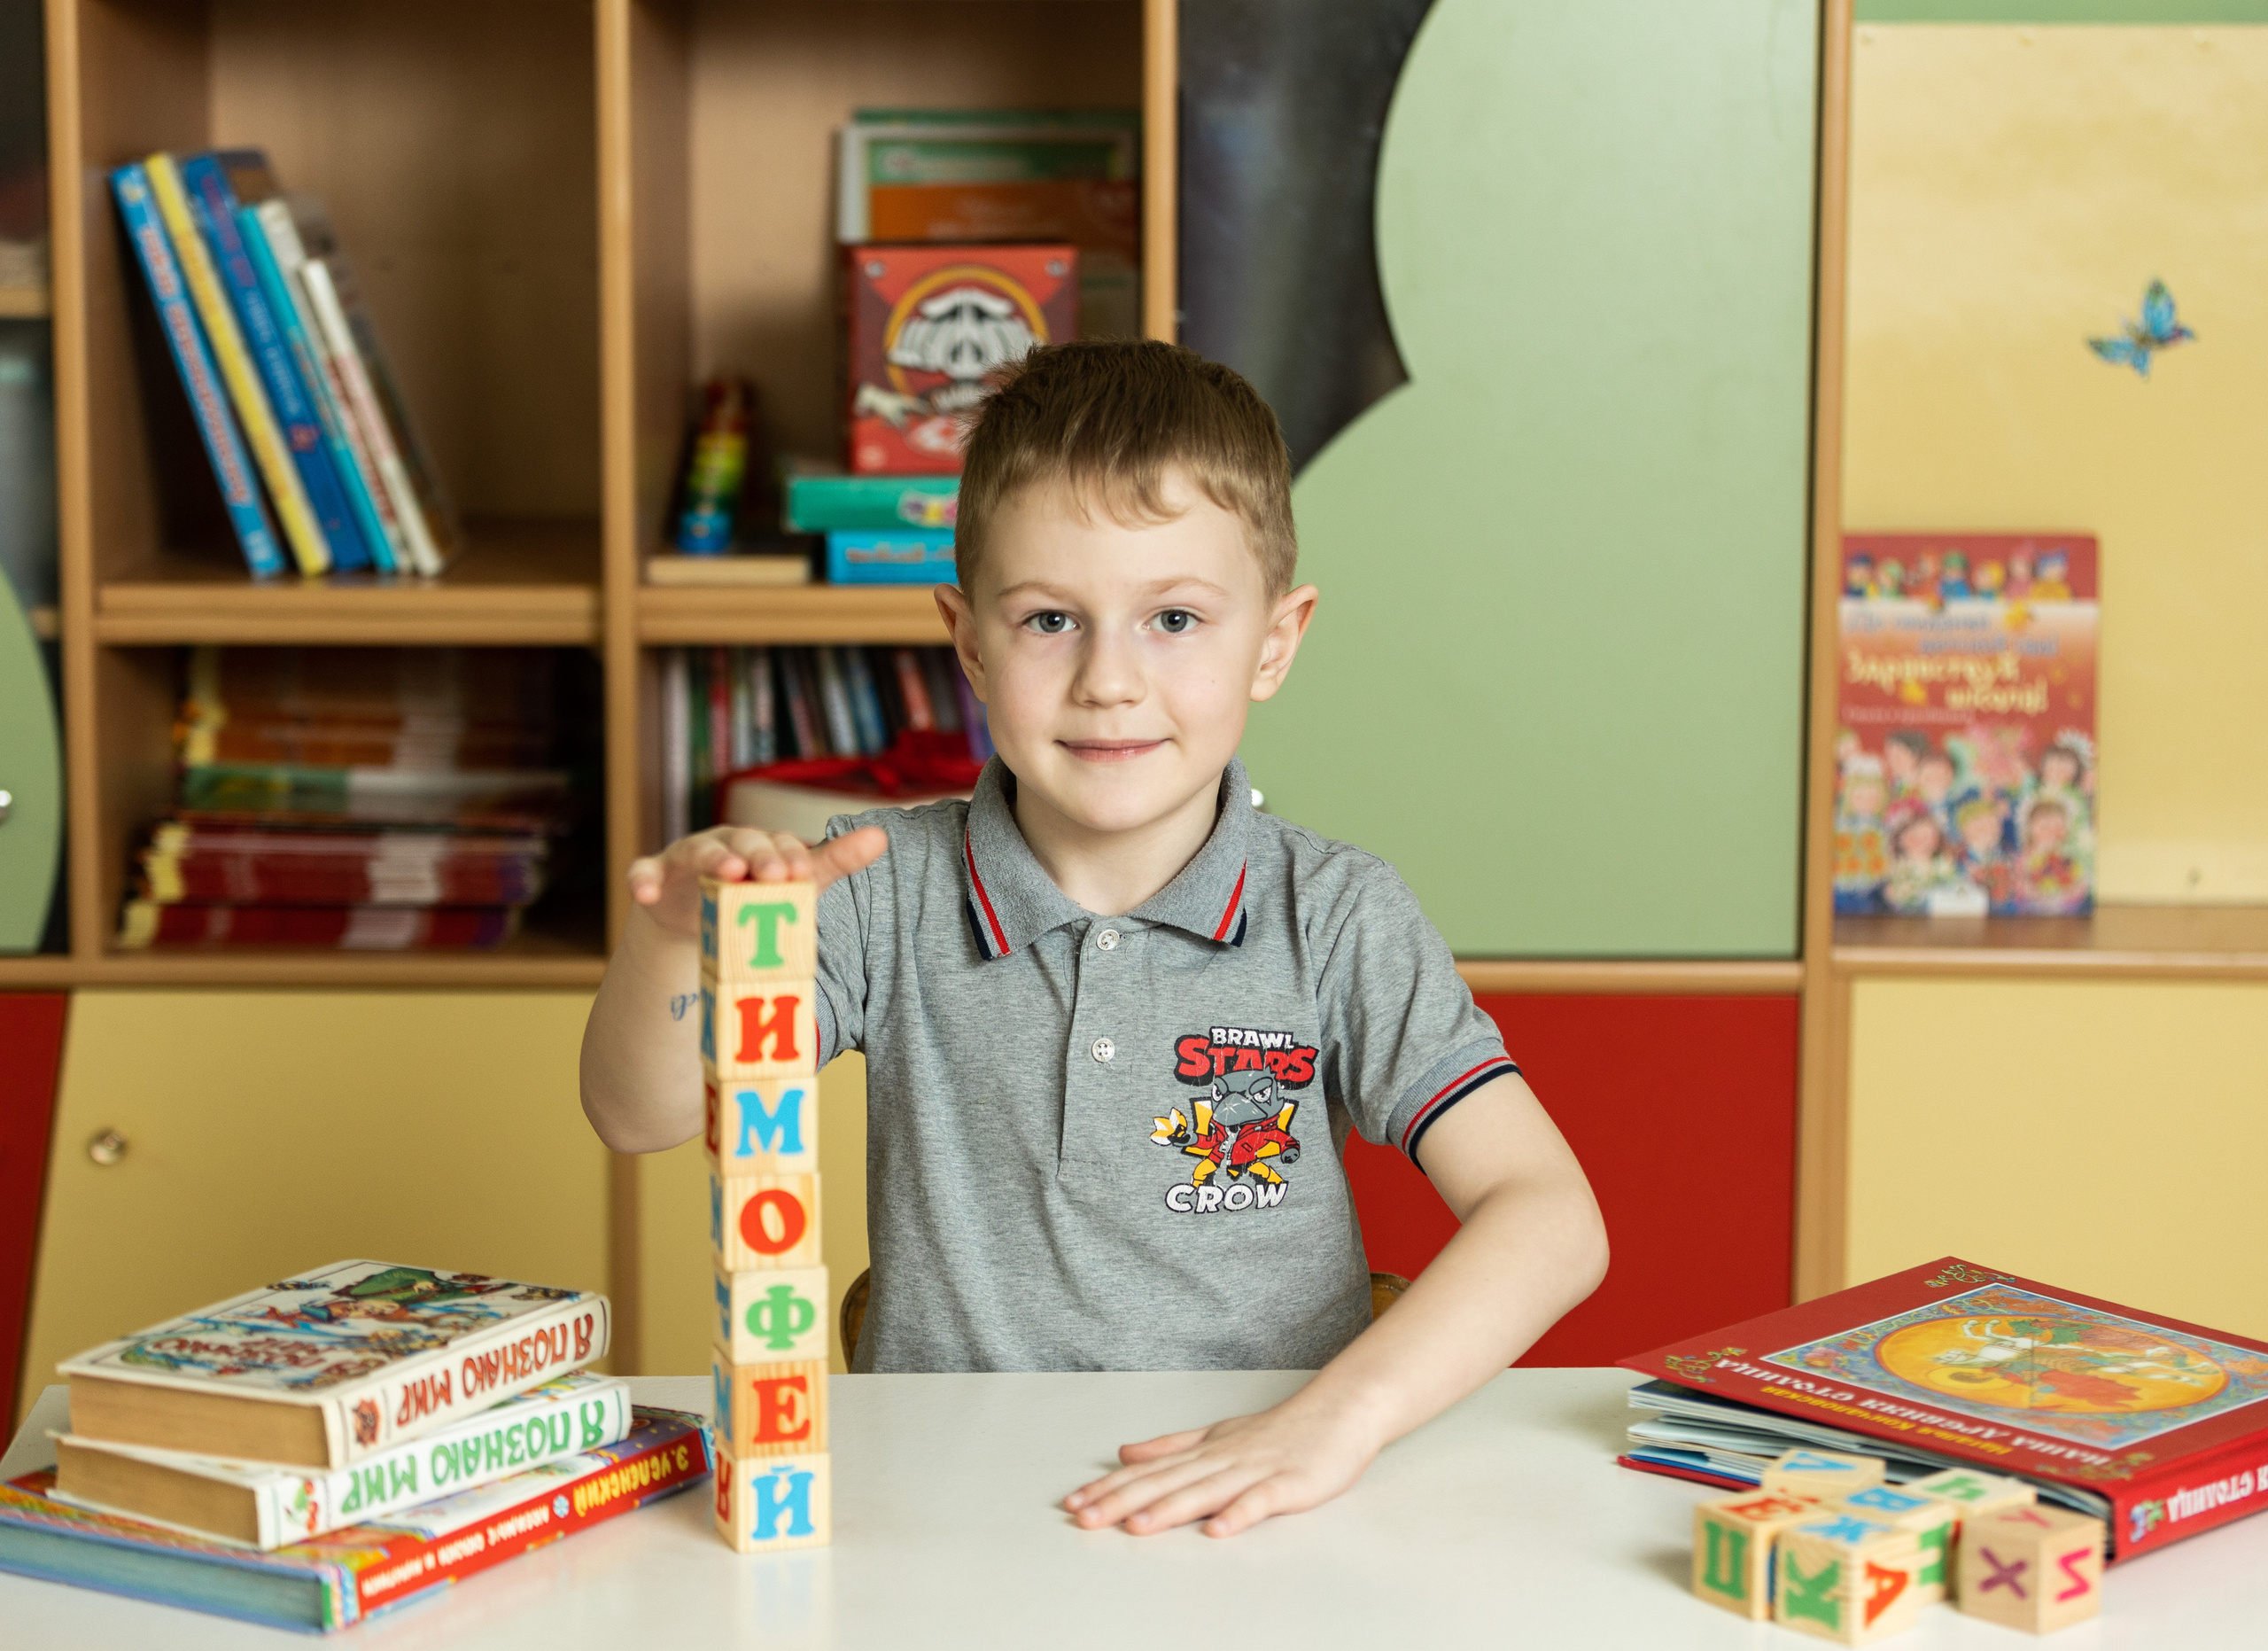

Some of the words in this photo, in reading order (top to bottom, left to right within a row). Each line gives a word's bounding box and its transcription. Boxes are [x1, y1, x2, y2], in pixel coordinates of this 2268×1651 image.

[1176, 1035, 1319, 1085] STARS
[1210, 1027, 1294, 1049] BRAWL
[1165, 1181, 1288, 1213] CROW
[462, 1322, 567, 1398] ПОЗНАЮ
[574, 1313, 594, 1362] Я
[397, 1369, 453, 1428] МИР
[1715, 1359, 1854, 1402] СТОЛИЦА
[579, 1400, 605, 1448] Я
[1760, 1385, 1914, 1431] Кончаловская
[1860, 1398, 2010, 1441] ДРЕВНЯЯ
[431, 1412, 571, 1486] ПОЗНАЮ
[341, 1454, 418, 1515] МИР
[573, 1453, 671, 1517] УСПЕНСКИЙ
[2167, 1470, 2256, 1523] СТОЛИЦА
